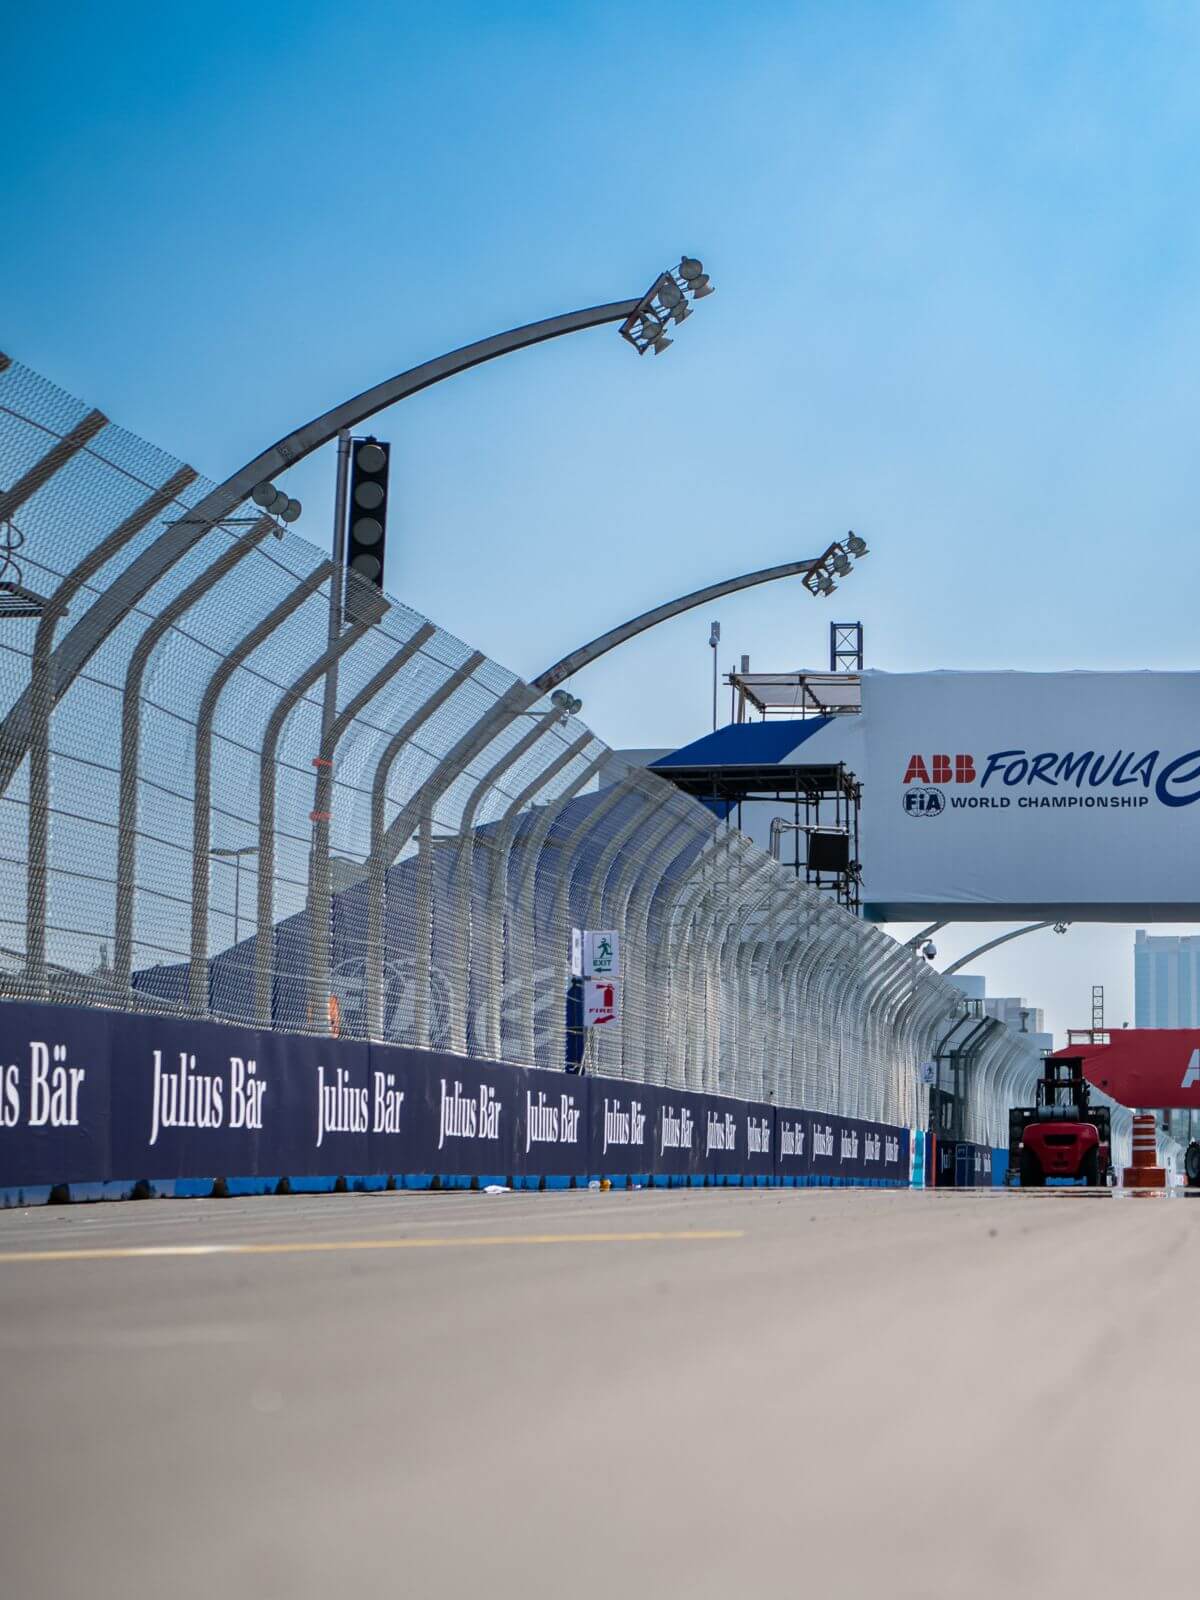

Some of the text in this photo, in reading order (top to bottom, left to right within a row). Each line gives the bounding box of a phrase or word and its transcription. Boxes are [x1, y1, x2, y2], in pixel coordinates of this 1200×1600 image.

[902, 754, 977, 784] ABB
[980, 749, 1160, 788] FORMULA
[951, 796, 1011, 808] WORLD
[1017, 796, 1149, 808] CHAMPIONSHIP
[592, 959, 612, 967] EXIT
[28, 1041, 86, 1127] Bär
[150, 1050, 267, 1146] Julius Bär
[316, 1066, 405, 1148] Julius Bär
[438, 1078, 502, 1150] Julius Bär
[526, 1090, 580, 1154] Julius Bär
[603, 1098, 646, 1155] Julius Bär
